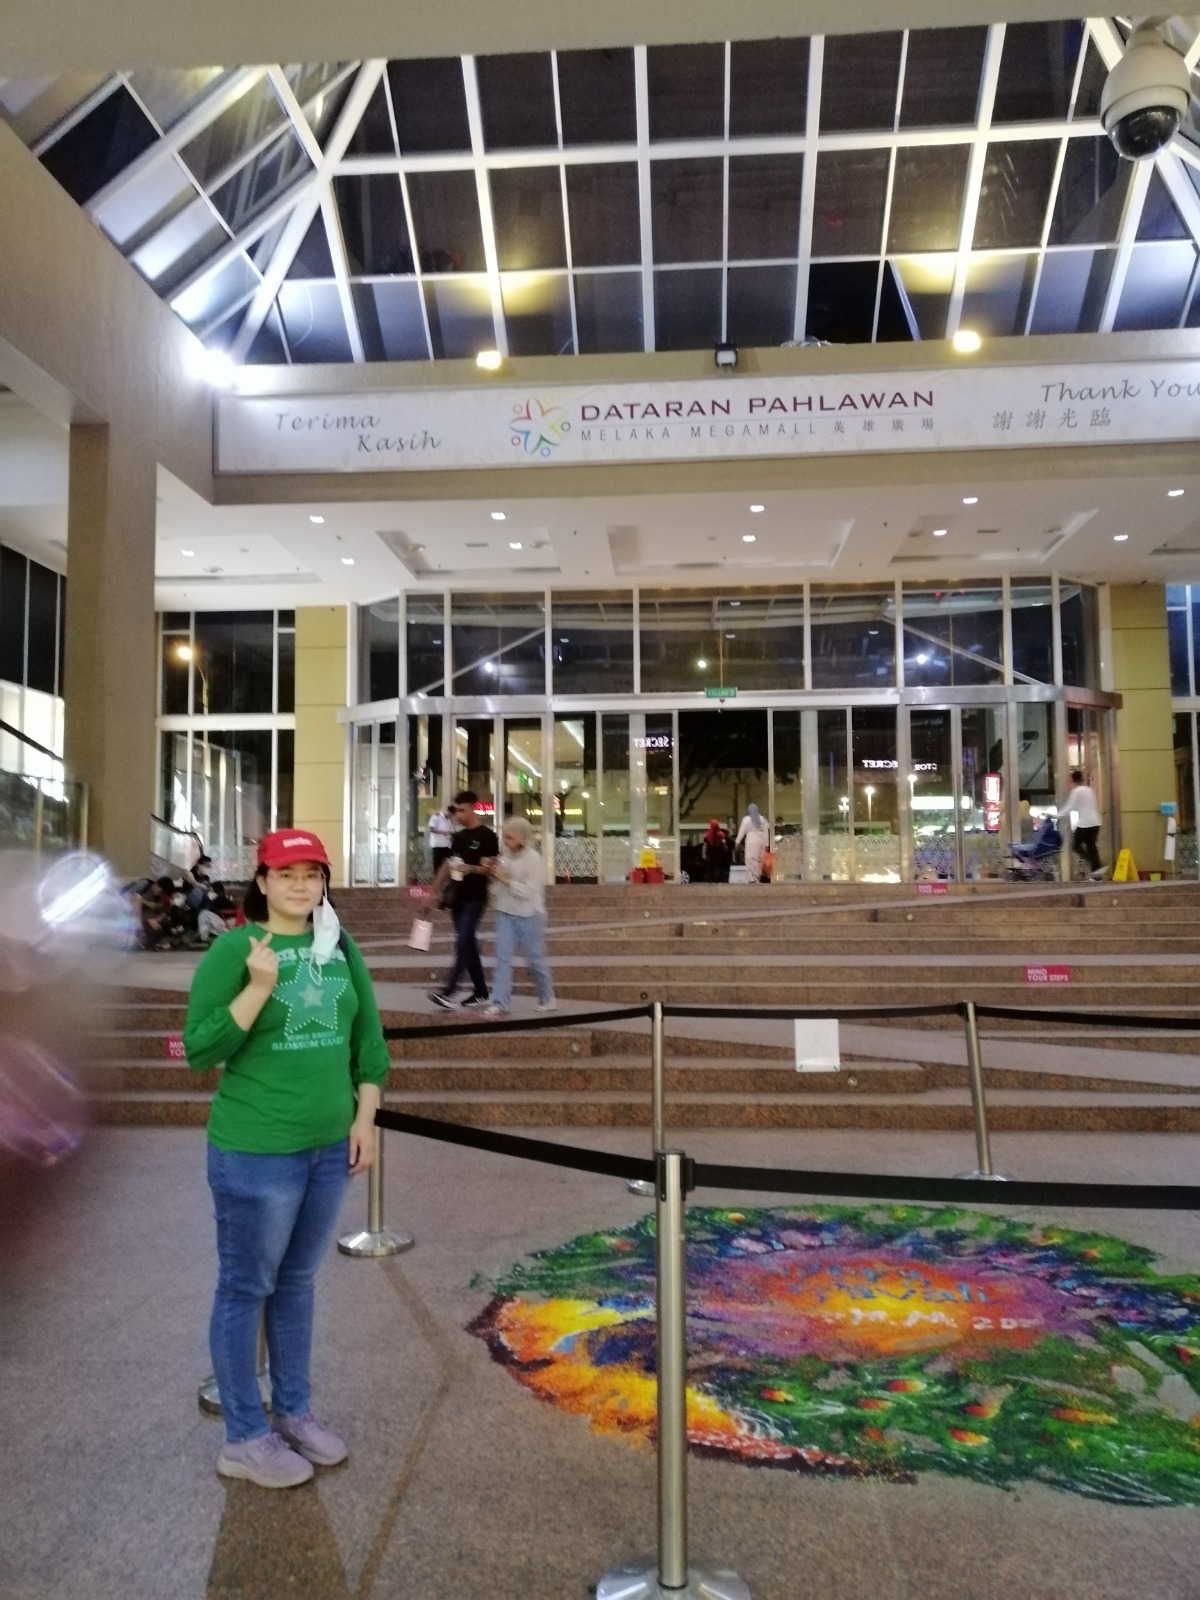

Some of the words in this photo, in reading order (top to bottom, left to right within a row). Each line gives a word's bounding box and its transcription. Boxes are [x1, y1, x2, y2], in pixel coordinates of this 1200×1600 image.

[1041, 380, 1141, 401] Thank
[1150, 380, 1200, 397] You
[581, 399, 731, 421] DATARAN
[749, 391, 934, 414] PAHLAWAN
[275, 412, 382, 431] Terima
[833, 418, 934, 434] 英雄廣場
[993, 406, 1111, 430] 謝謝光臨
[357, 430, 442, 452] Kasih
[581, 427, 670, 441] MELAKA
[690, 423, 816, 437] MEGAMALL
[272, 1040, 319, 1051] BLOSSOM
